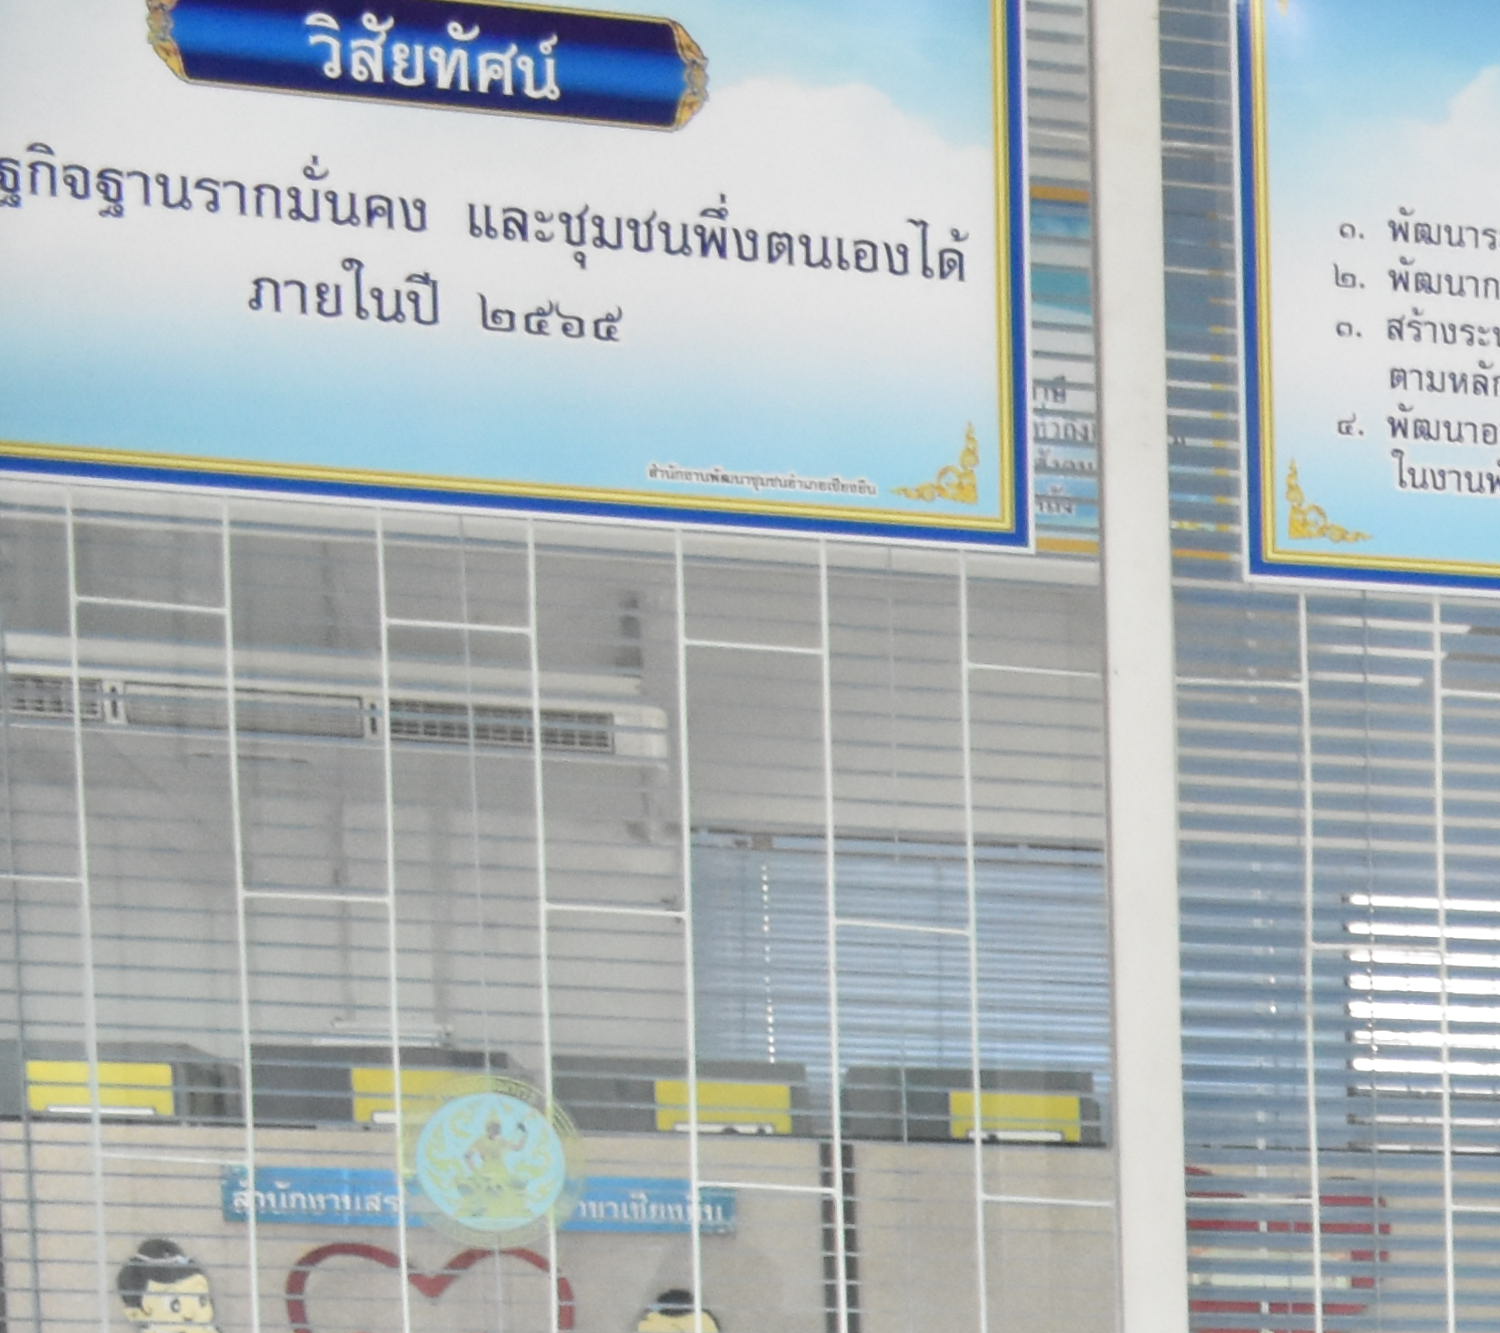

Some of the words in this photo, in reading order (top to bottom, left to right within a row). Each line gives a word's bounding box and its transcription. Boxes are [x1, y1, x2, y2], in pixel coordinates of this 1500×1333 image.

[305, 11, 560, 101] วิสัยทัศน์
[467, 192, 968, 284] และชุมชนพึ่งตนเองได้
[249, 258, 440, 329] ภายในปี
[476, 296, 624, 346] ๒๕๖๕
